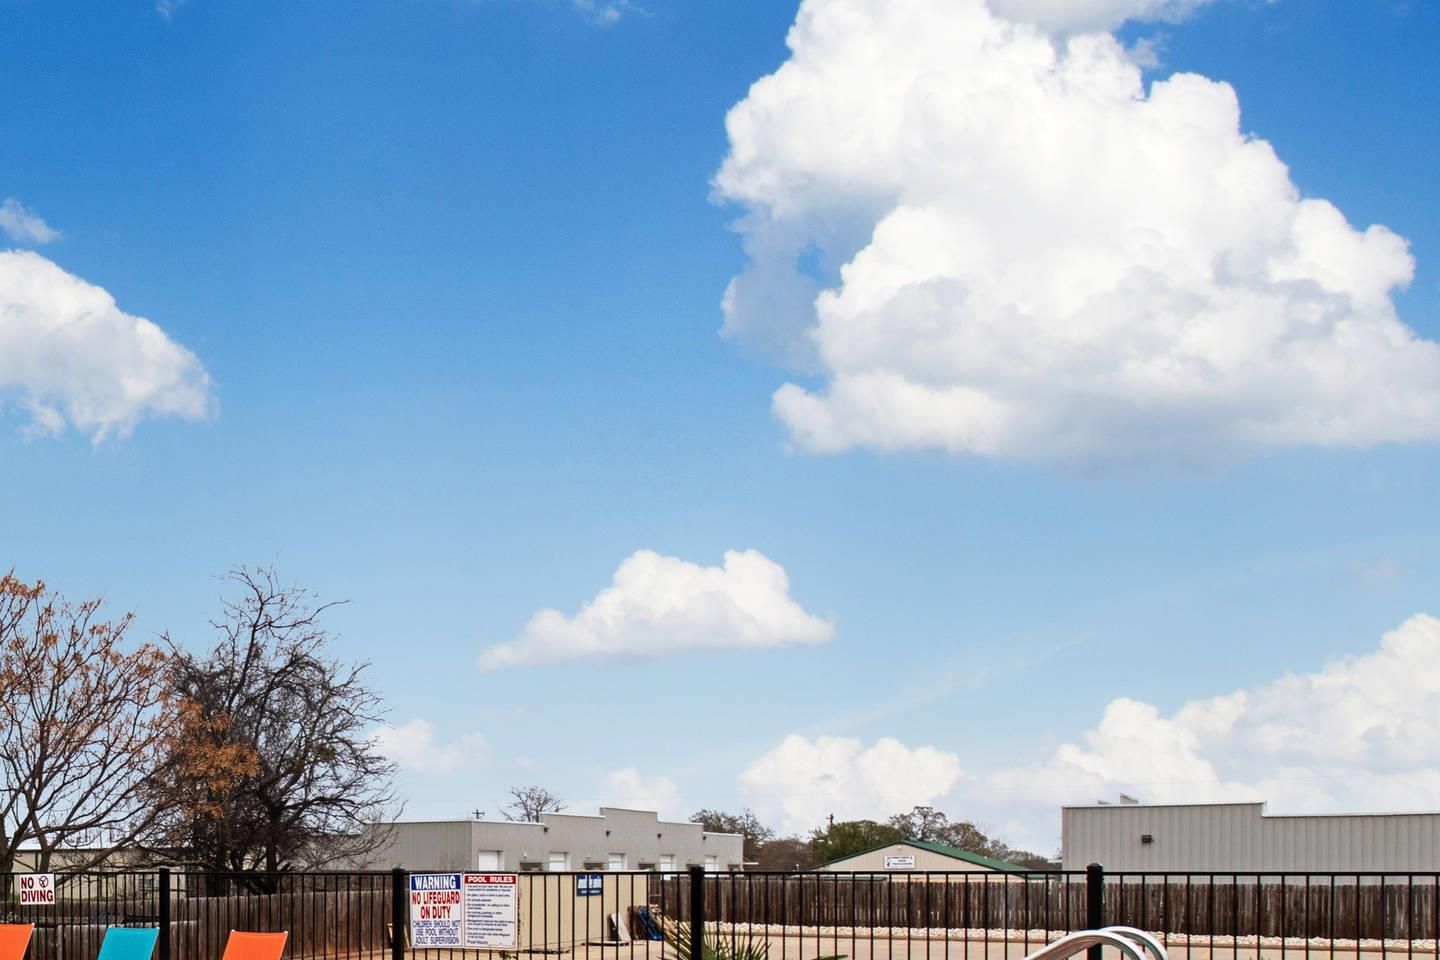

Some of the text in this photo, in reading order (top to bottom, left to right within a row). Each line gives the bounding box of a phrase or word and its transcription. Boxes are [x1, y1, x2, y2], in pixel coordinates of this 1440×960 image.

[21, 877, 34, 889] NO
[415, 876, 456, 890] WARNING
[21, 890, 53, 902] DIVING
[412, 891, 460, 904] NO LIFEGUARD
[420, 906, 451, 919] ON DUTY
[413, 920, 432, 928] CHILDREN
[451, 920, 461, 928] NOT
[415, 928, 424, 936] USE
[425, 928, 437, 936] POOL
[438, 928, 459, 936] WITHOUT
[415, 937, 459, 945] ADULT SUPERVISION
